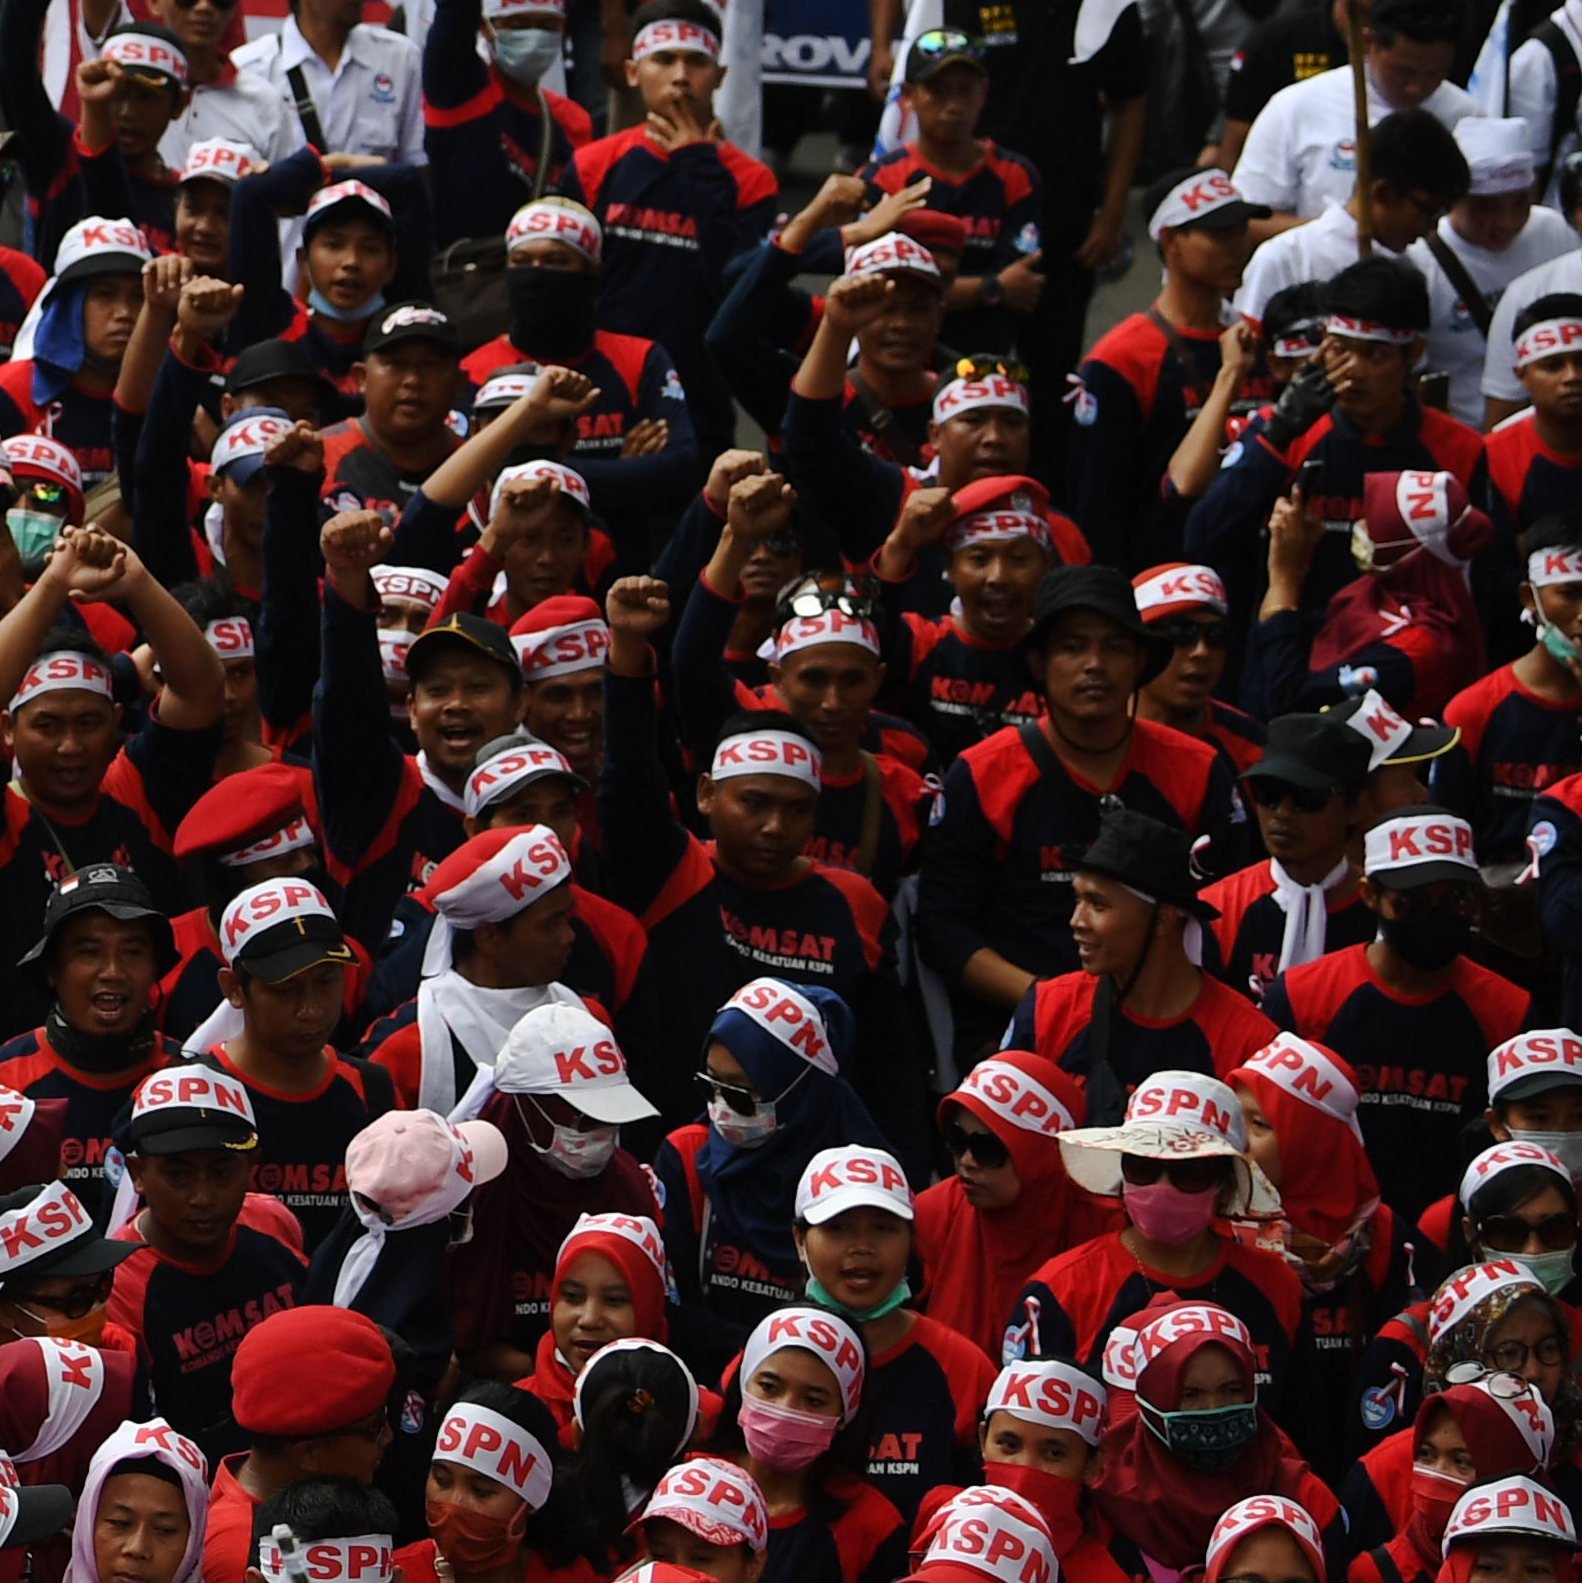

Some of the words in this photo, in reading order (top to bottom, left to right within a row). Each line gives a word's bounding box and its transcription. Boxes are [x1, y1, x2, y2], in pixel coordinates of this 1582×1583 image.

[508, 210, 602, 257] KSPN
[1517, 323, 1582, 357] KSP
[6, 440, 77, 480] SPN
[521, 627, 611, 673] KSP
[16, 657, 112, 704] KSP
[1388, 823, 1476, 861] KSP
[499, 835, 569, 900] KSP
[1251, 1038, 1335, 1094] SPN
[1497, 1032, 1582, 1075] KSP
[810, 1156, 905, 1198] KSP
[287, 1194, 339, 1207] KESATUAN
[0, 1190, 85, 1260] KSP
[1002, 1373, 1107, 1436] KSP
[439, 1416, 537, 1490] SPN
[886, 1461, 919, 1475] KSPN
